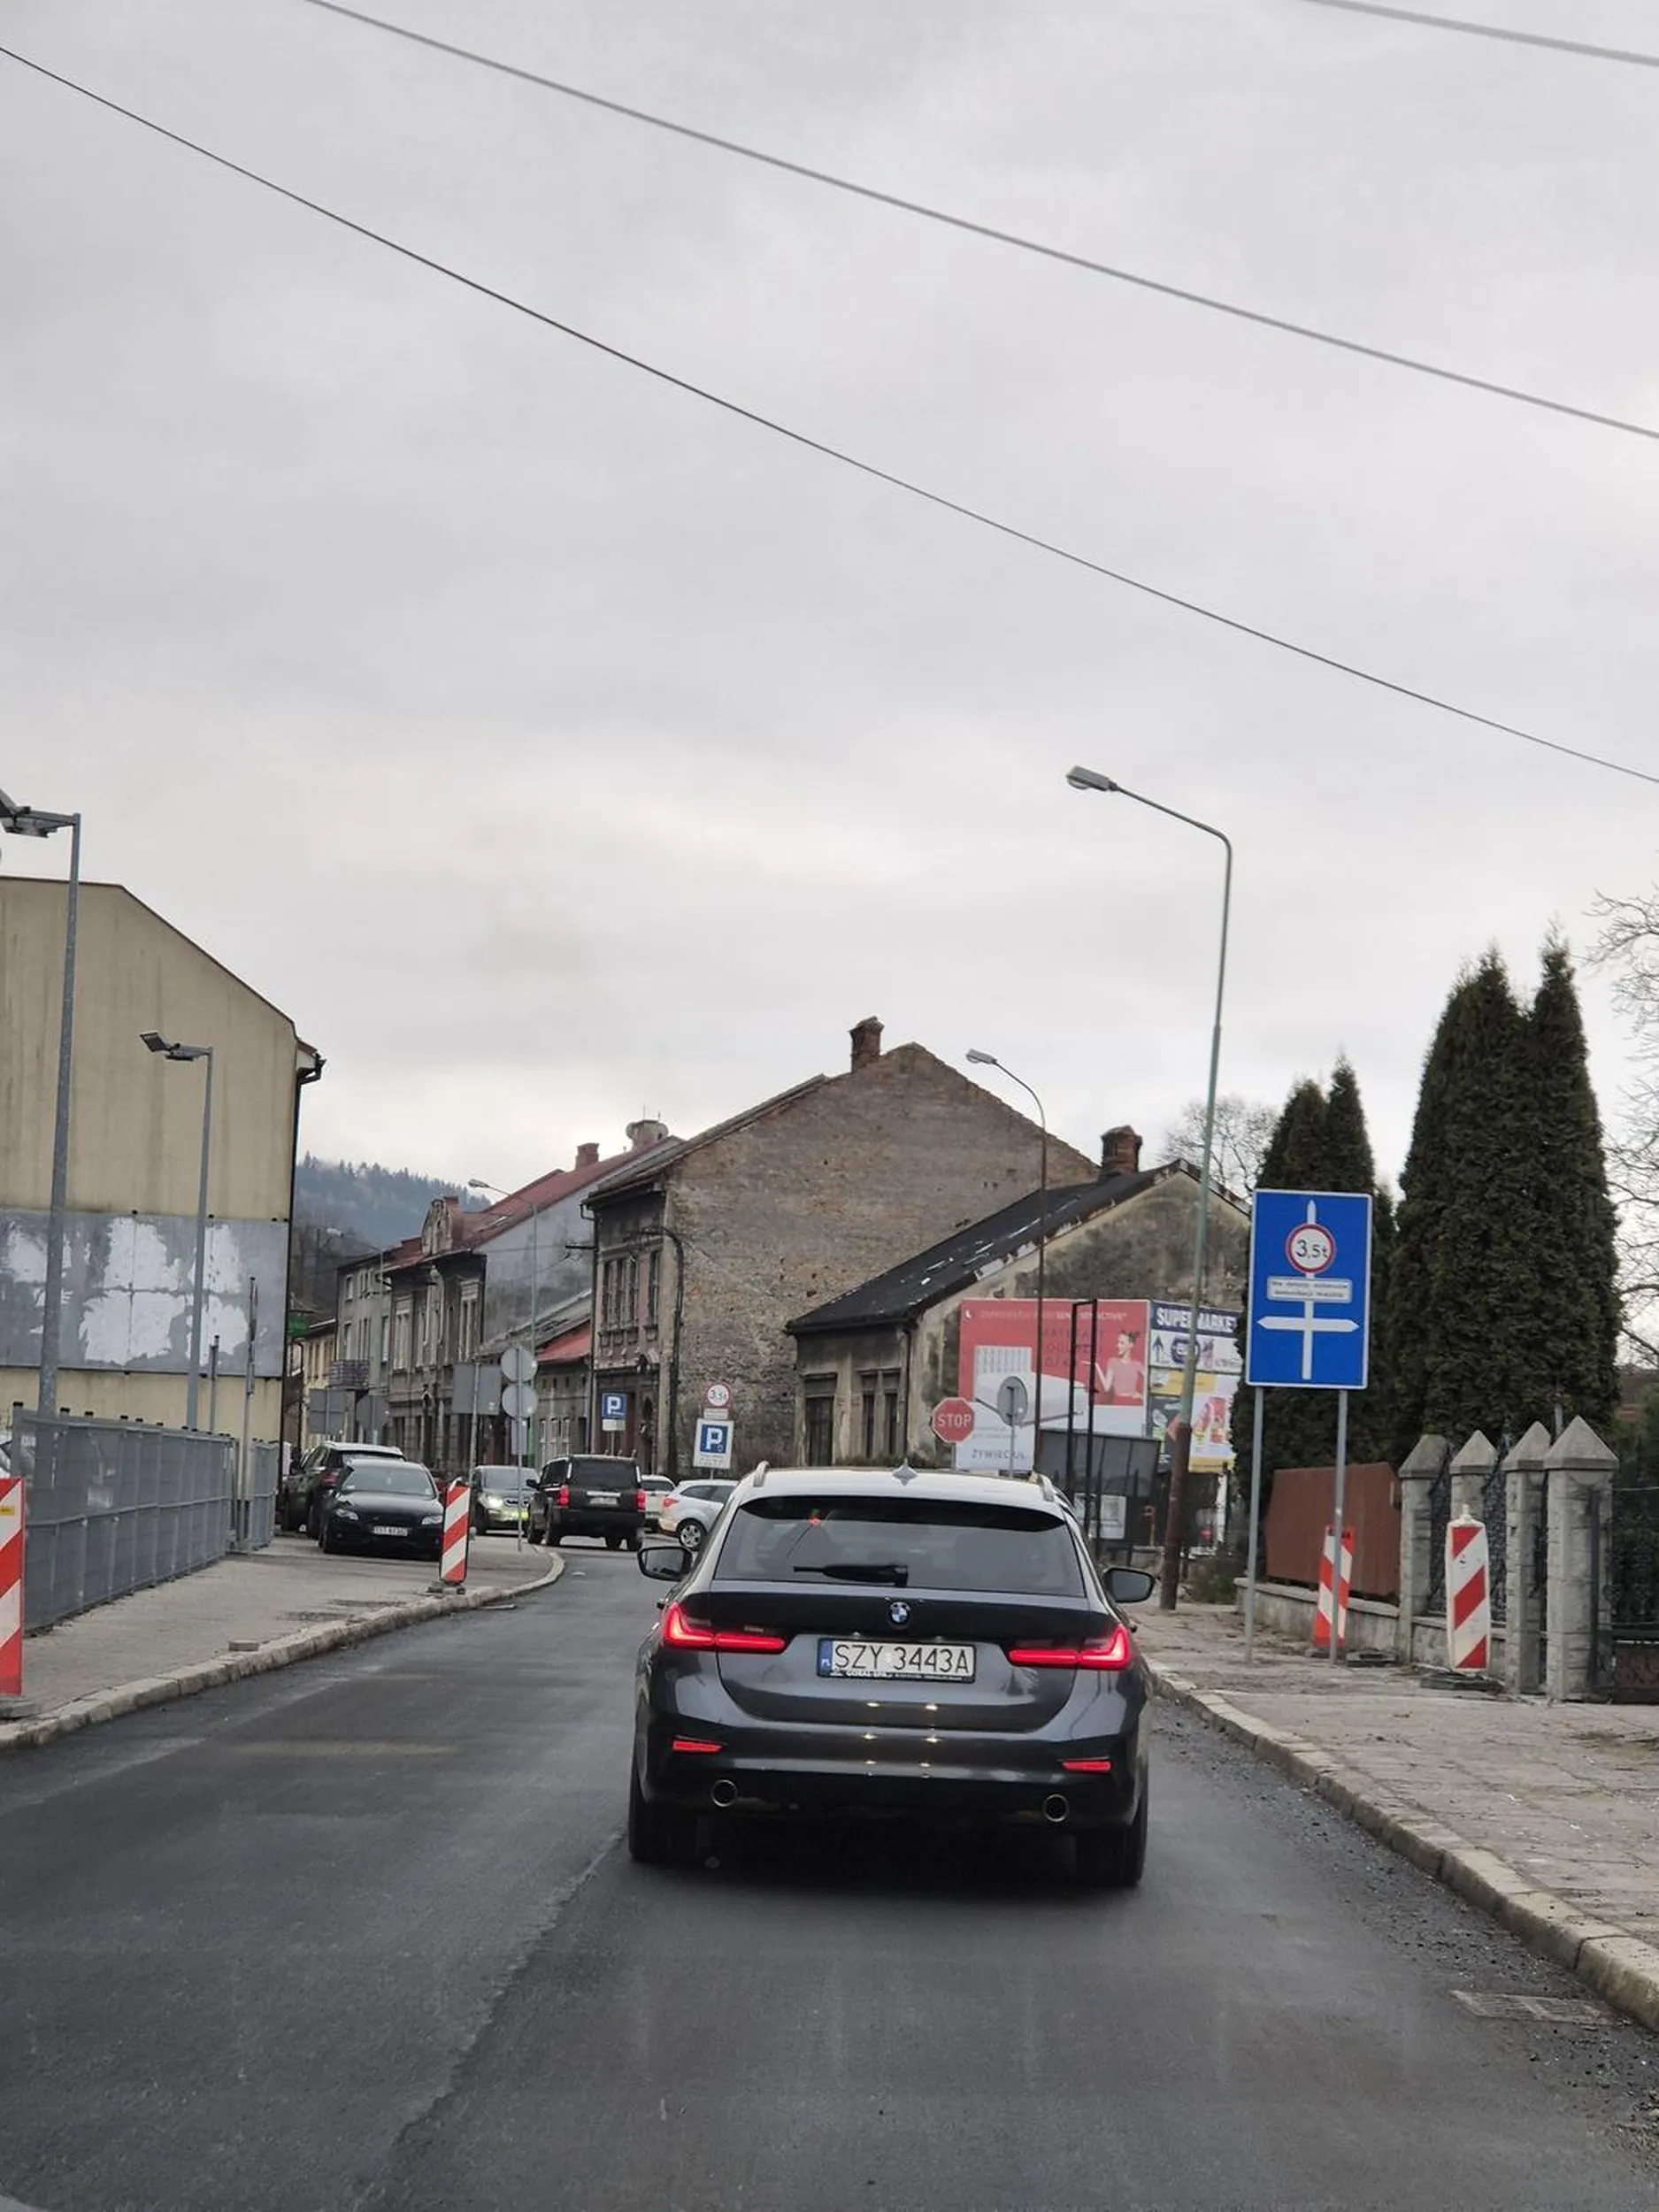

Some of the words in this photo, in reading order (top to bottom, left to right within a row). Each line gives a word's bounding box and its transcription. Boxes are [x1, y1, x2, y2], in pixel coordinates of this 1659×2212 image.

[607, 1396, 621, 1415] P
[938, 1414, 972, 1428] STOP
[705, 1427, 723, 1450] P
[835, 1644, 883, 1670] SZY
[894, 1647, 969, 1673] 3443A
